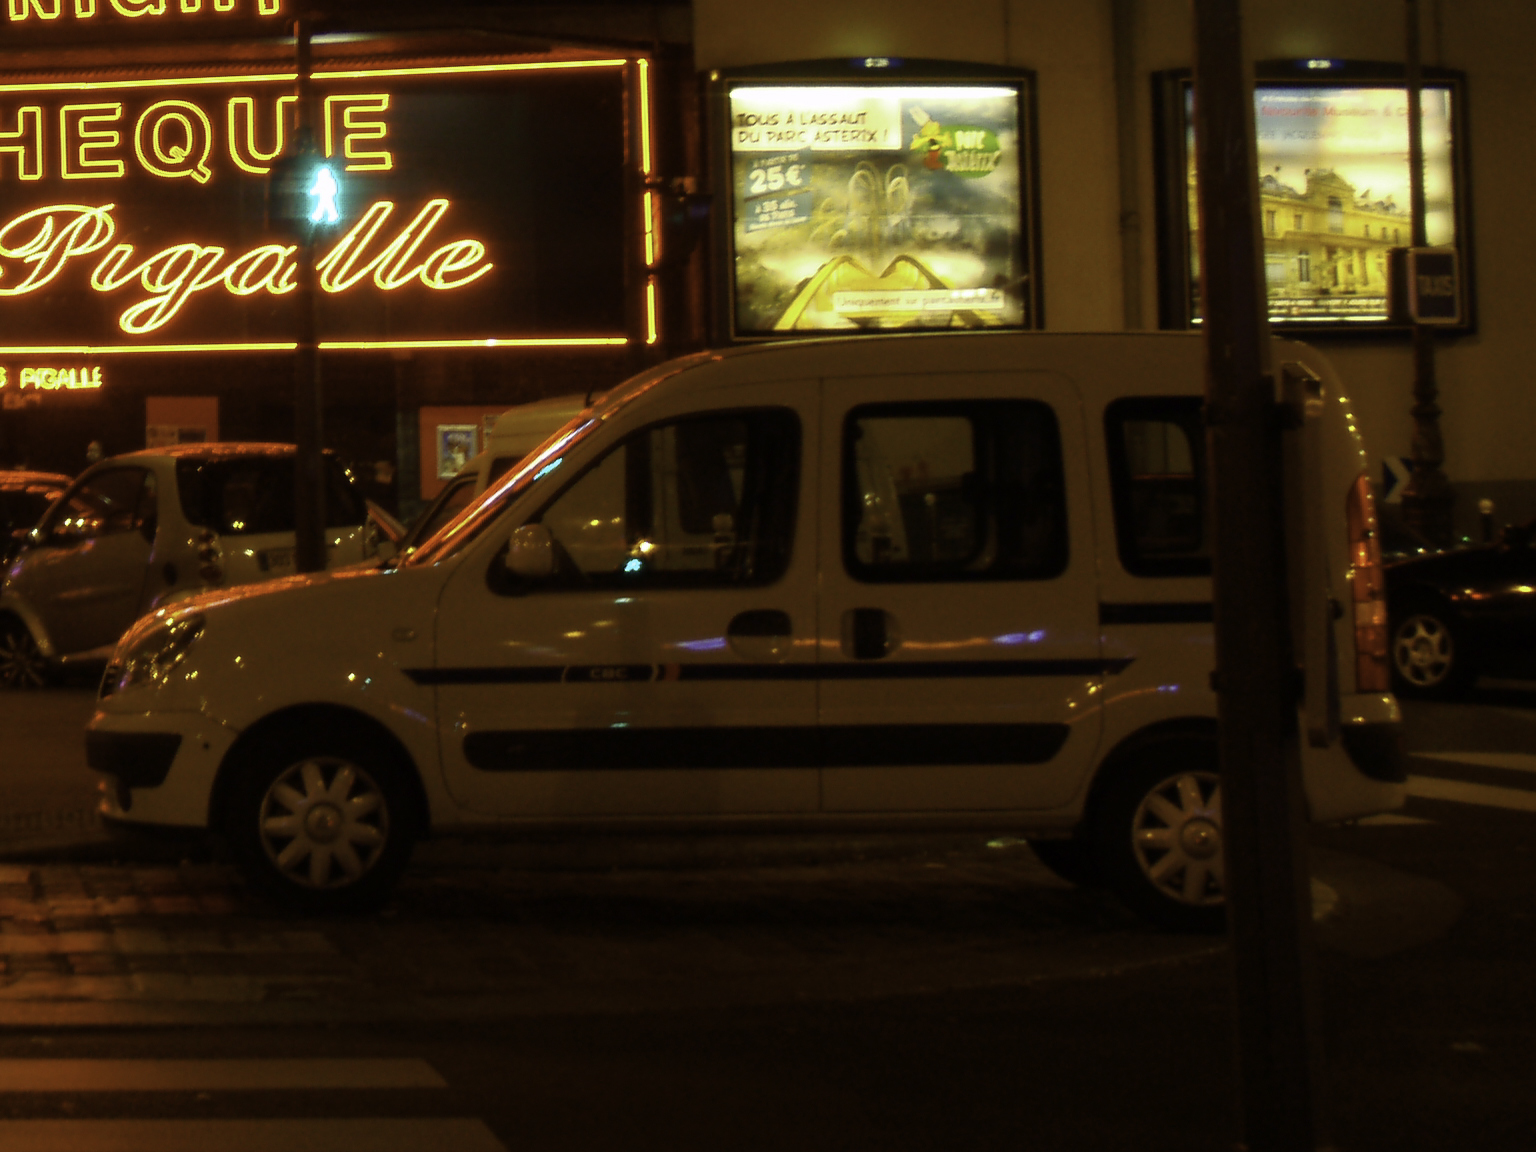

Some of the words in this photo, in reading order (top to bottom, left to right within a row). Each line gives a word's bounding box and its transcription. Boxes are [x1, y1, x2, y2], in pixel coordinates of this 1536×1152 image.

[736, 110, 781, 127] TOUS
[737, 128, 761, 145] DU
[766, 128, 808, 144] PARC
[18, 365, 104, 392] PIGALLE
